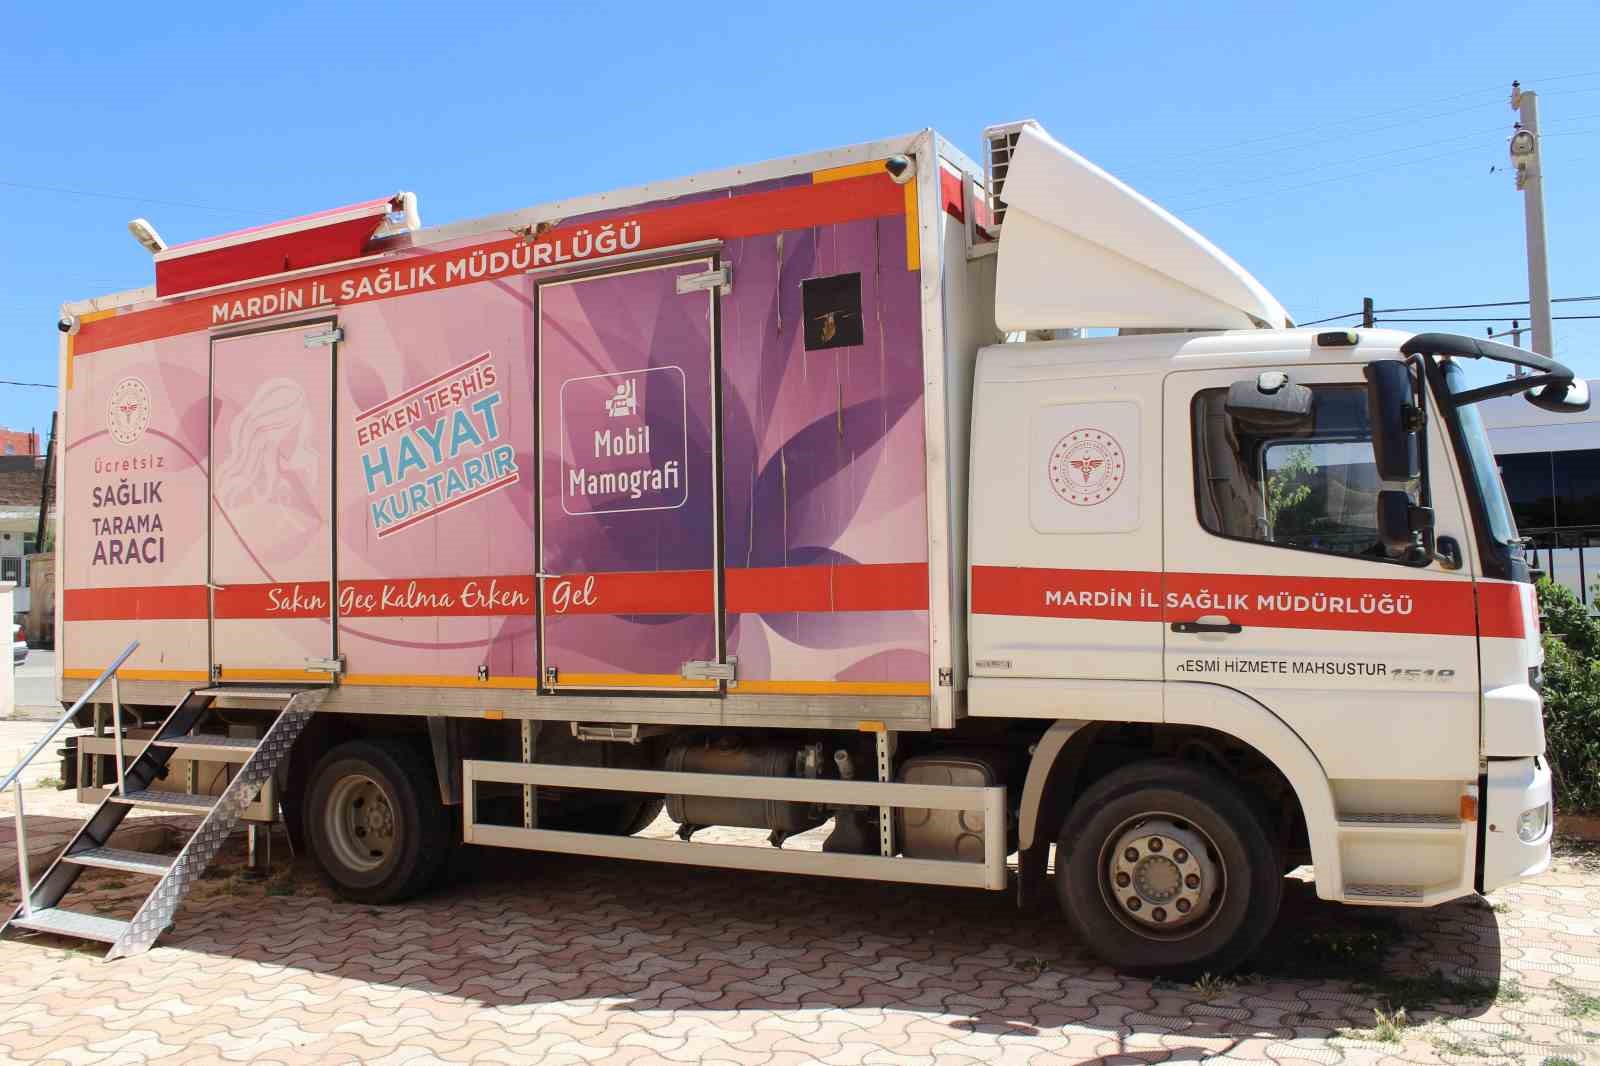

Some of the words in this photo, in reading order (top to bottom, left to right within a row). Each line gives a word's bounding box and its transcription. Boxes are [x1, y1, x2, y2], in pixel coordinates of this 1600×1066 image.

[211, 286, 304, 324] MARDİN
[311, 280, 333, 306] İL
[340, 263, 437, 301] SAĞLIK
[445, 220, 641, 283] MÜDÜRLÜĞÜ
[356, 401, 421, 446] ERKEN
[424, 366, 497, 414] TEŞHİS
[361, 392, 502, 493] HAYAT
[594, 425, 650, 458] Mobil
[92, 478, 163, 508] SAĞLIK
[371, 446, 518, 529] KURTARIR
[568, 460, 679, 499] Mamografi
[92, 513, 164, 537] TARAMA
[92, 537, 165, 566] ARACI
[338, 586, 375, 618] Geç
[380, 580, 454, 611] Kalma
[460, 581, 529, 609] Erken
[551, 575, 598, 613] Gel
[1045, 588, 1132, 608] MARDİN
[1140, 589, 1159, 608] İL
[1166, 589, 1249, 610] SAĞLIK
[1256, 592, 1413, 615] MÜDÜRLÜĞÜ
[1224, 658, 1288, 674] HİZMETE
[1291, 660, 1387, 677] MAHSUSTUR
